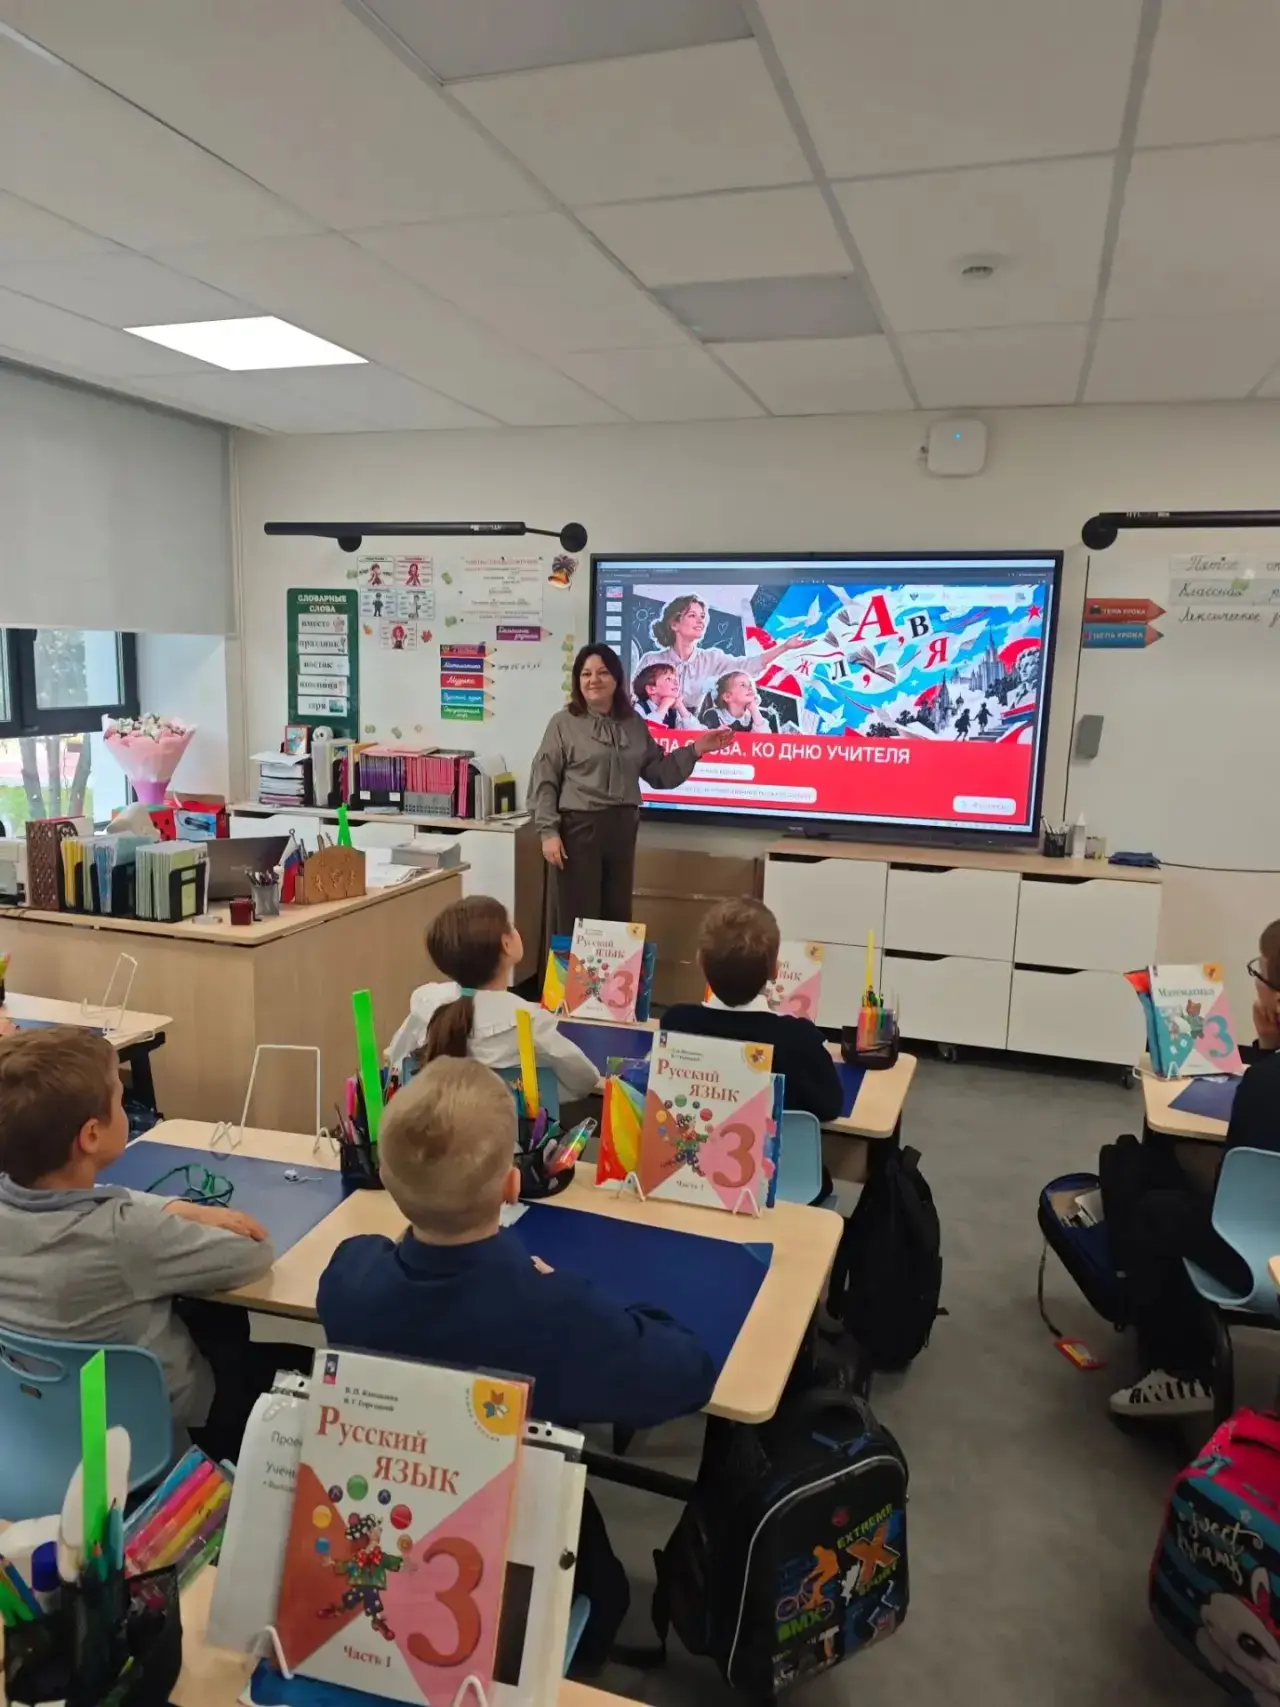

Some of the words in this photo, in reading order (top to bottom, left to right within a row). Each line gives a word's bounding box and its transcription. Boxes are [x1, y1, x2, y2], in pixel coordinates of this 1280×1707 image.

[309, 605, 336, 613] СЛОВА
[751, 742, 775, 757] КО
[778, 743, 822, 760] ДНЮ
[826, 745, 911, 764] УЧИТЕЛЯ
[608, 970, 634, 1009] 3
[1206, 1015, 1234, 1058] 3
[656, 1058, 720, 1083] Русский
[712, 1123, 756, 1188] 3
[316, 1404, 428, 1454] Русский
[407, 1536, 484, 1668] 3
